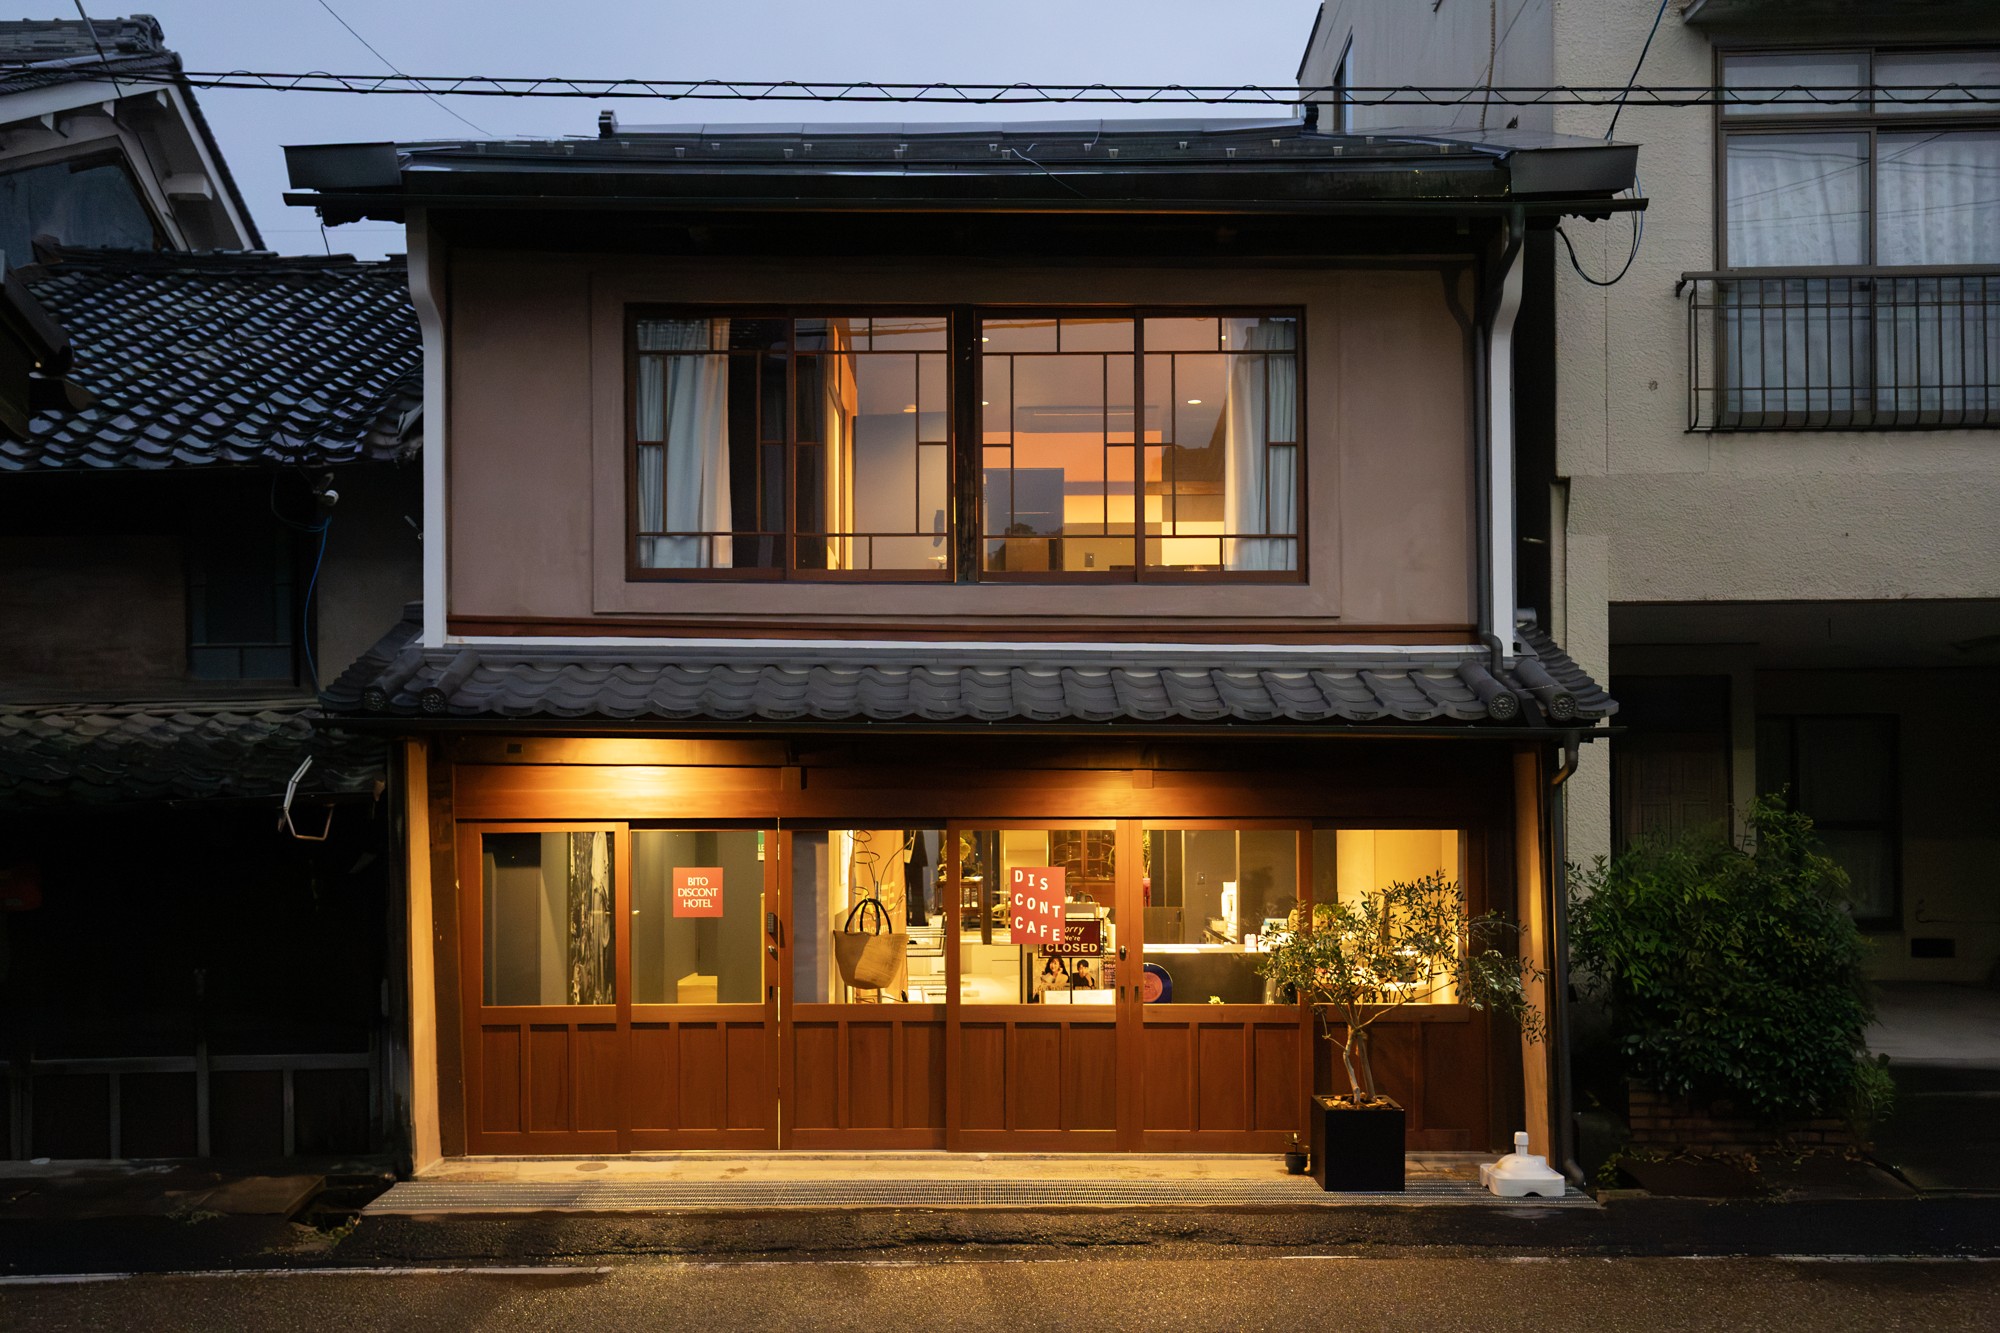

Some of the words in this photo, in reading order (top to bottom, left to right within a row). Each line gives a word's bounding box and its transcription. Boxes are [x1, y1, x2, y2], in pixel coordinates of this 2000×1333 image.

[687, 877, 708, 886] BITO
[1015, 870, 1048, 890] DIS
[677, 888, 718, 897] DISCONT
[683, 899, 712, 908] HOTEL
[1015, 894, 1061, 918] CONT
[1015, 917, 1060, 941] CAFE
[1065, 926, 1084, 935] orry
[1046, 943, 1098, 953] CLOSED
